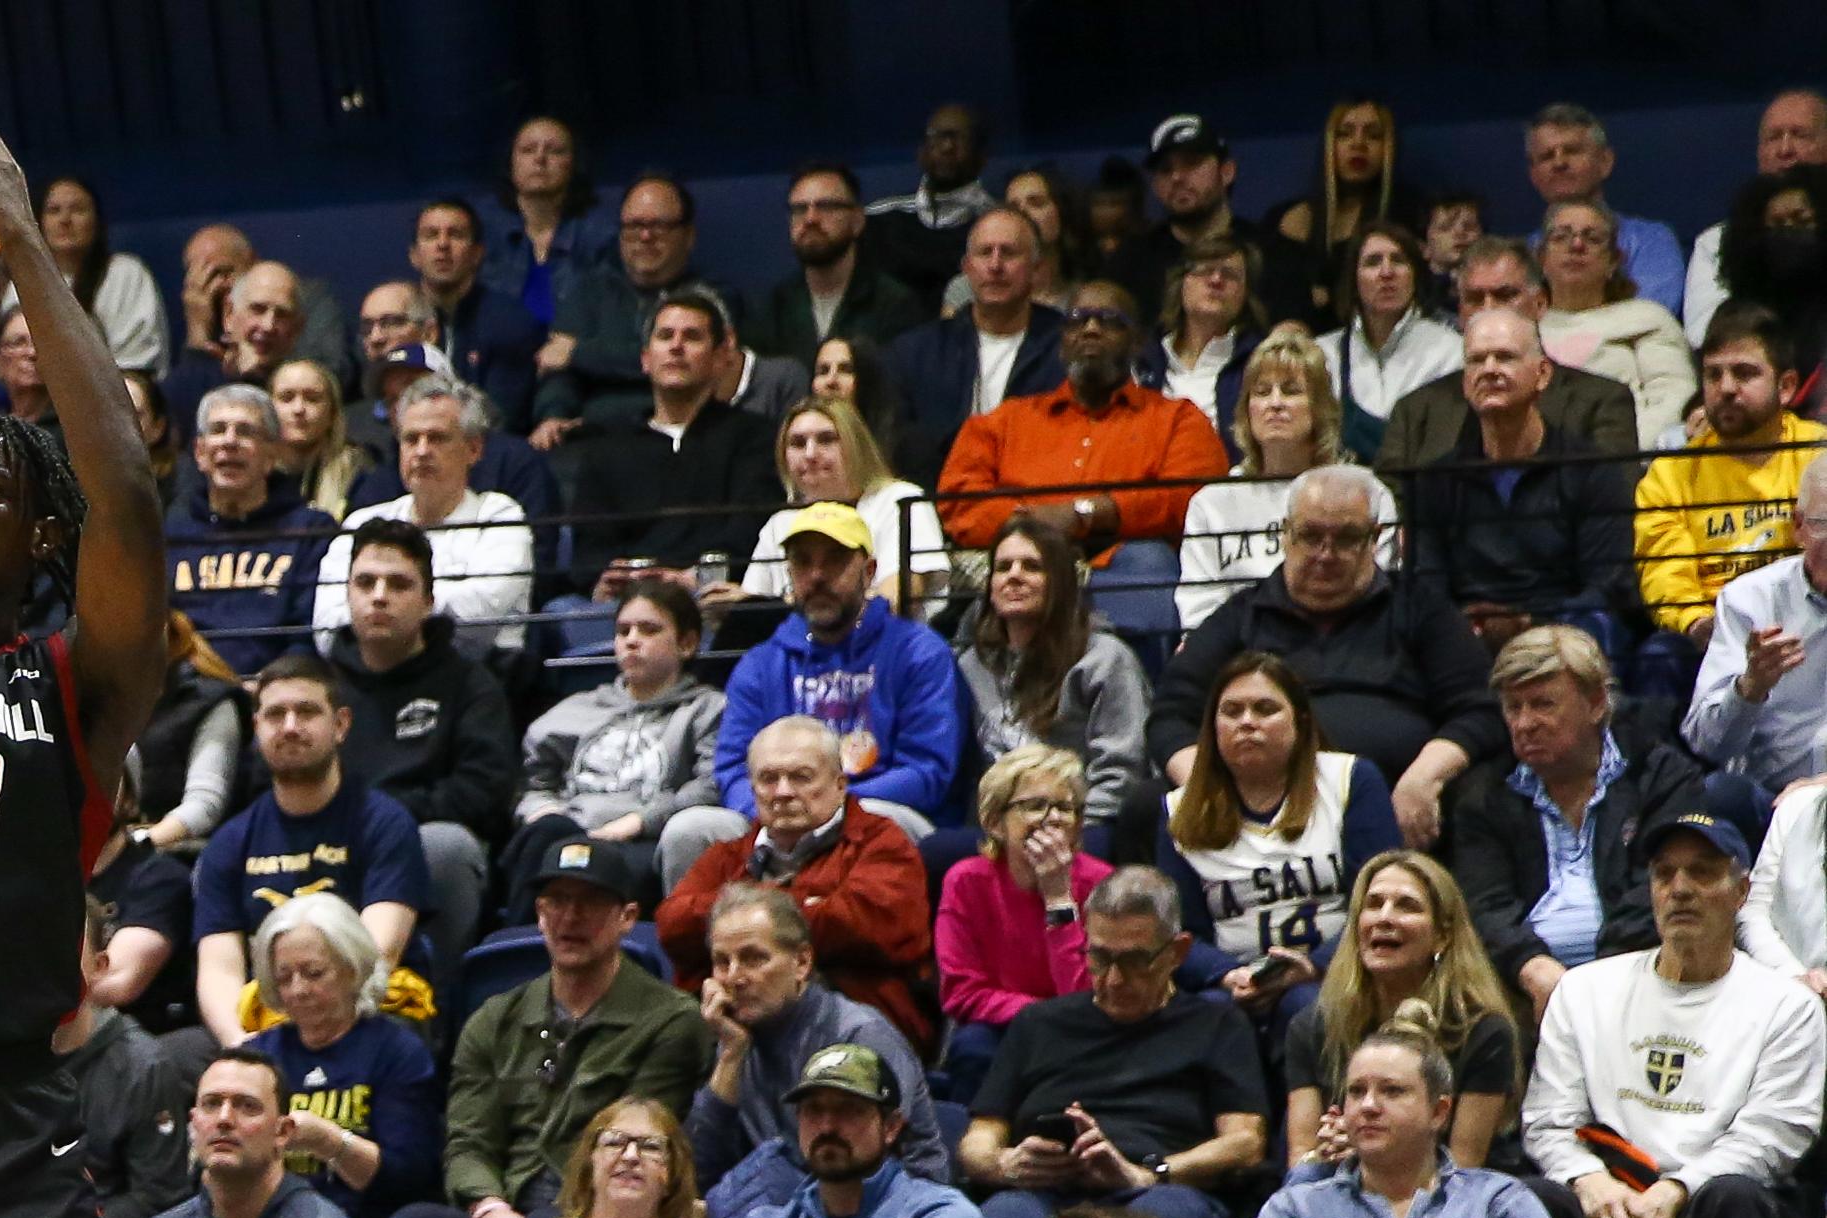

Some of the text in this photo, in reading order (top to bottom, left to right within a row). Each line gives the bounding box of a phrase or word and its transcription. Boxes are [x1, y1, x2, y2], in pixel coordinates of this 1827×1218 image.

[1706, 512, 1735, 538] LA
[198, 550, 293, 590] SALLE
[1218, 531, 1252, 570] LA
[1258, 902, 1323, 954] 14
